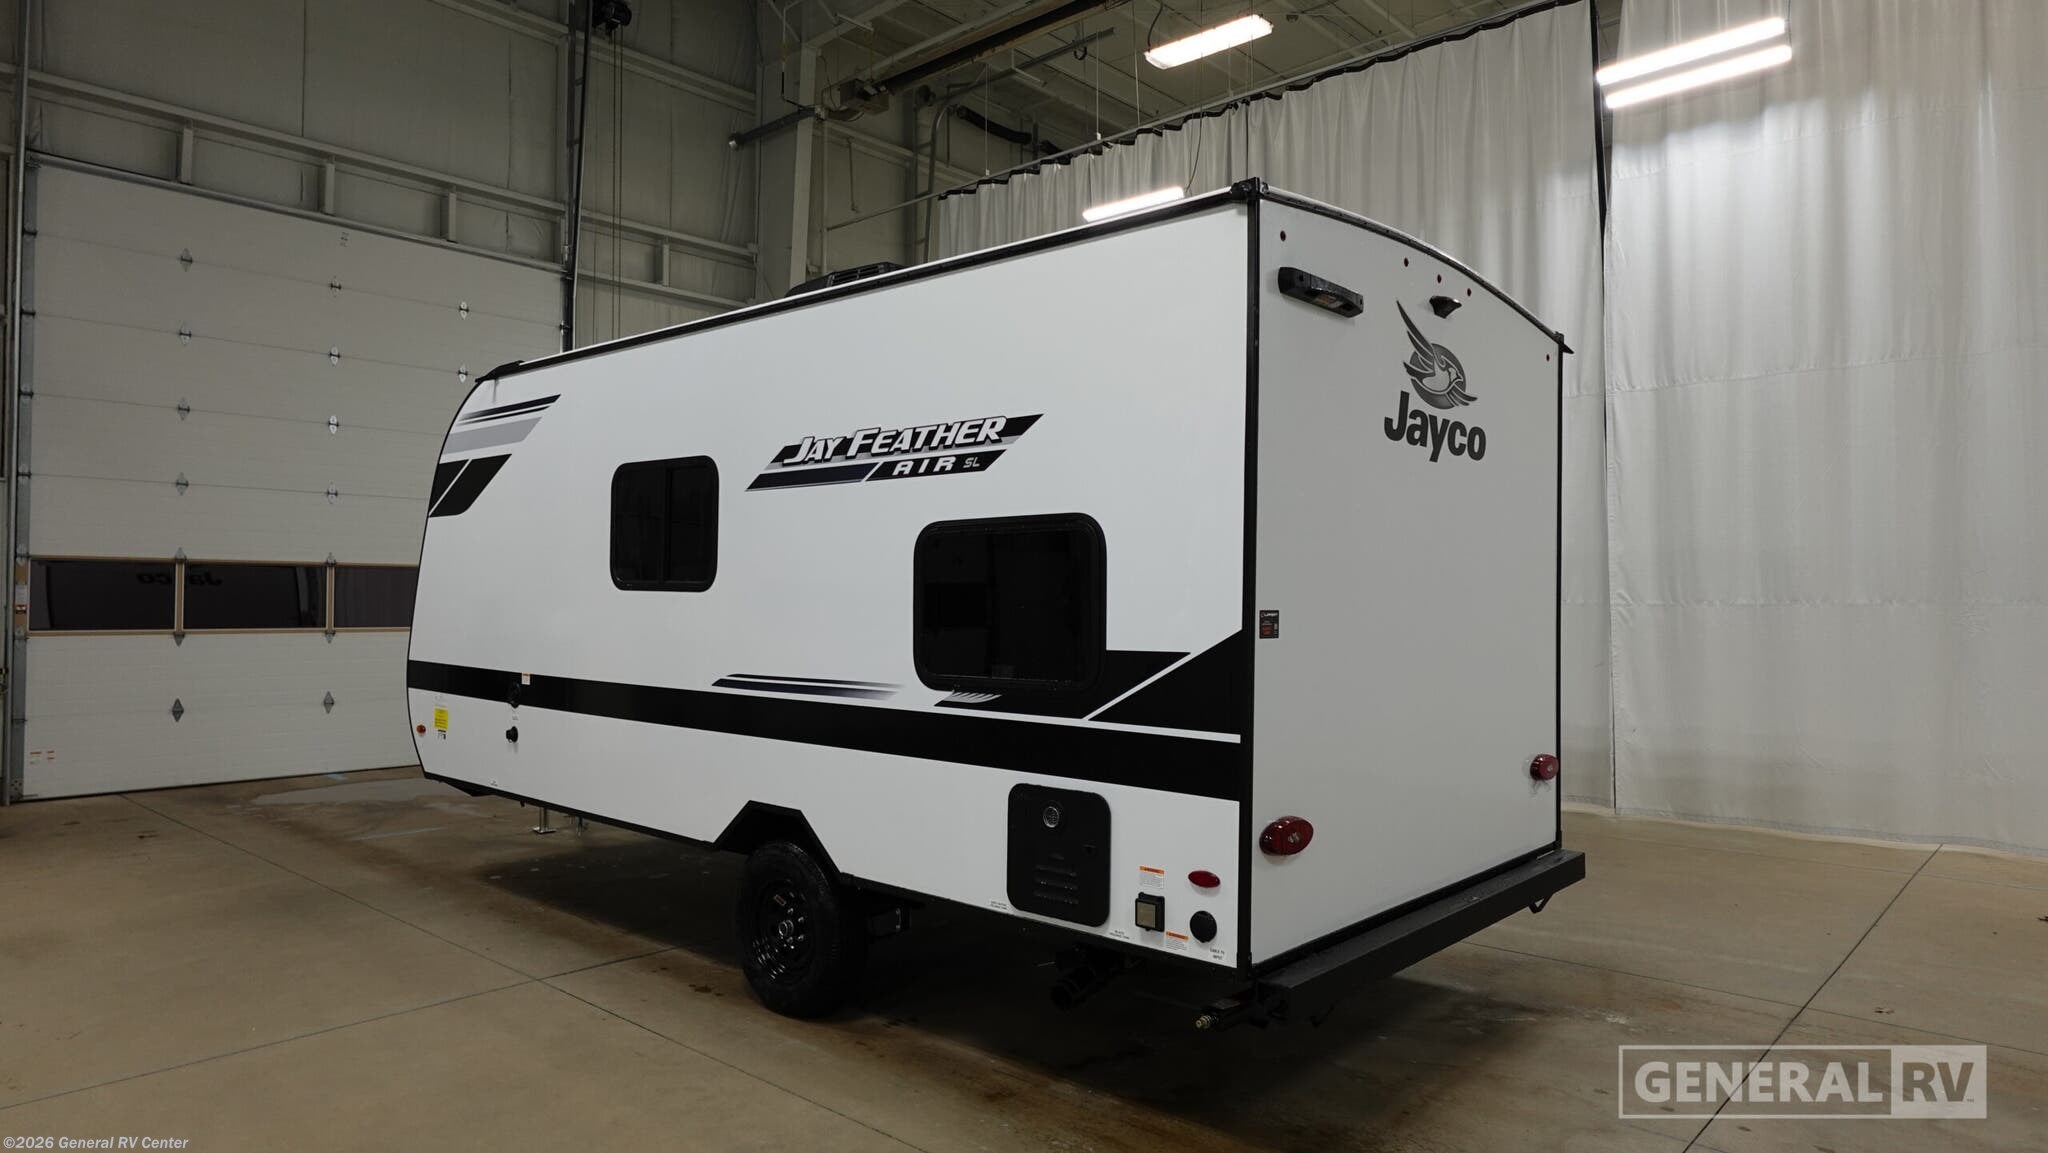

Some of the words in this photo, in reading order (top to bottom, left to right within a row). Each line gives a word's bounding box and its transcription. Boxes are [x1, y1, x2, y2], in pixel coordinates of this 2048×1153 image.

[782, 436, 847, 465] JAY
[845, 415, 1007, 459] FEATHER
[1384, 390, 1486, 463] Jayco
[891, 456, 957, 476] AIR
[963, 457, 980, 469] SL
